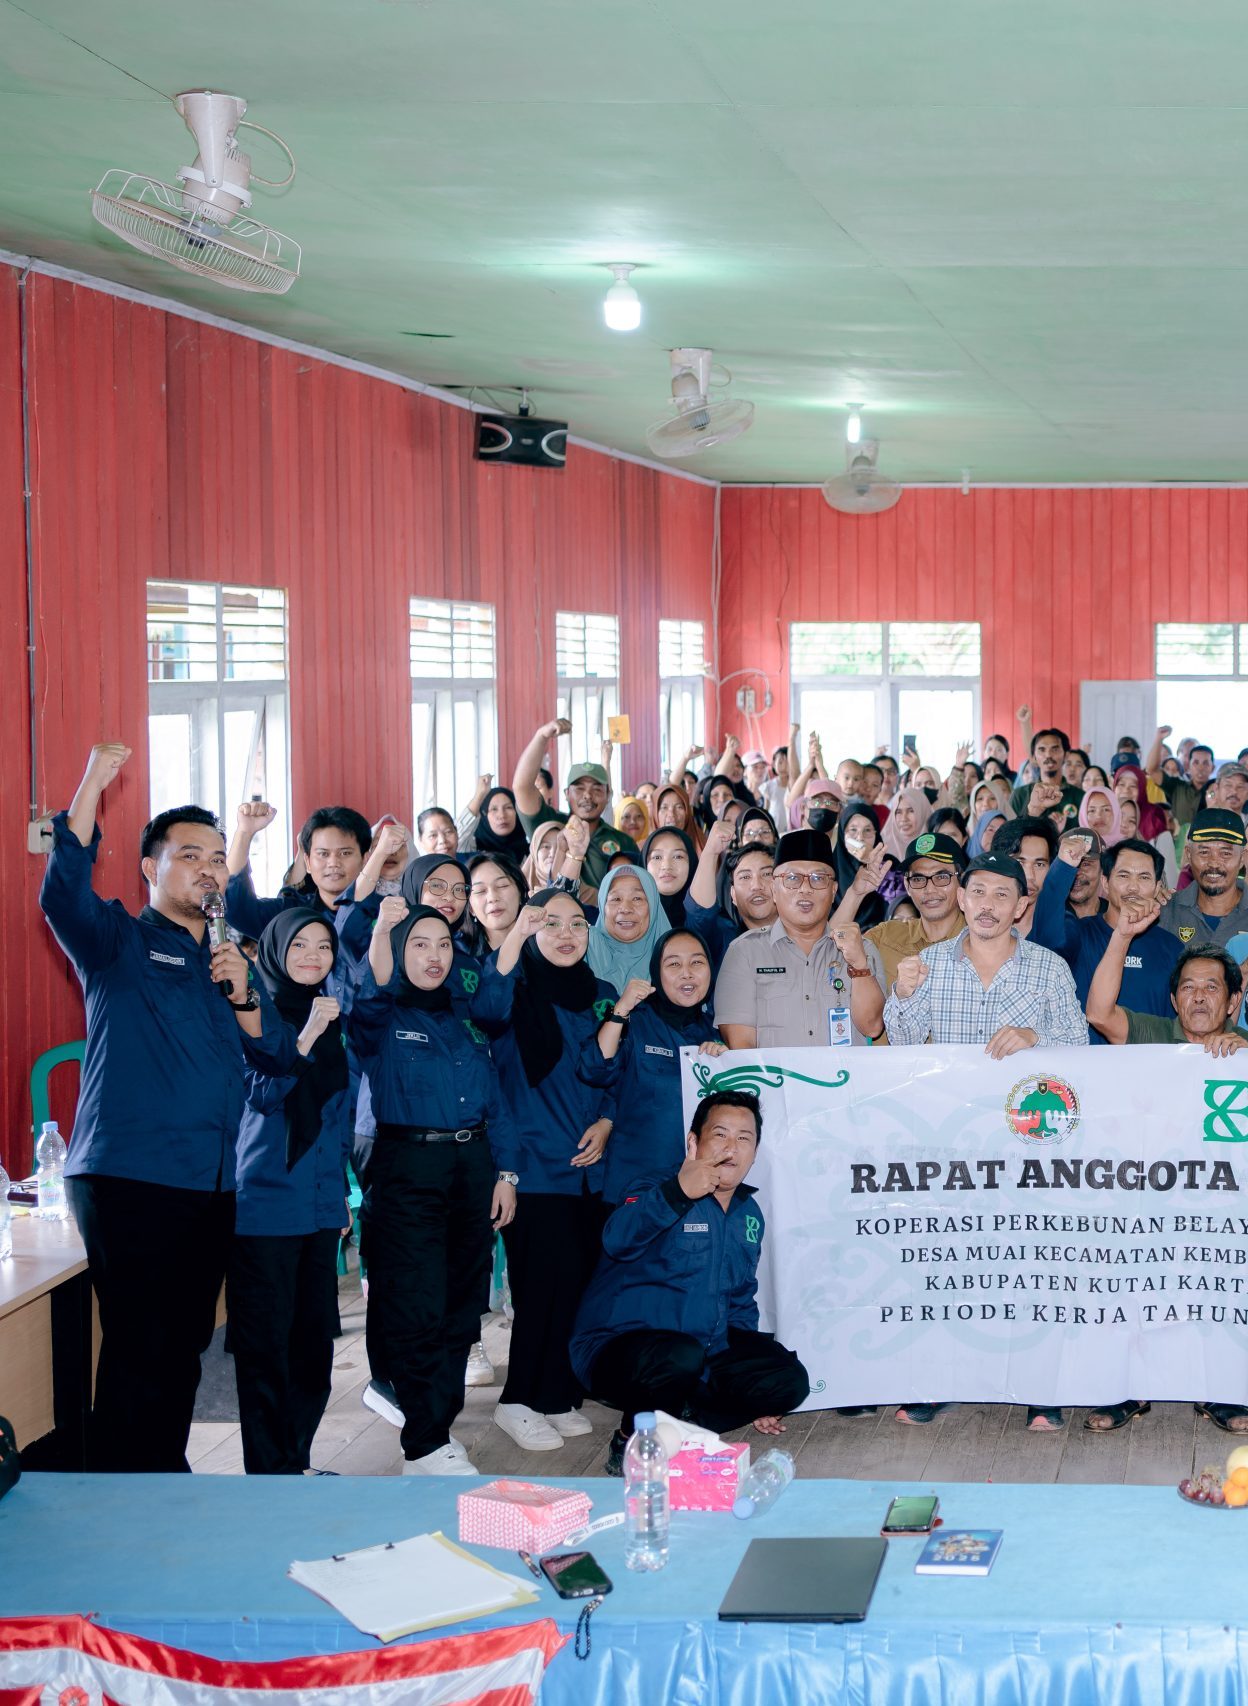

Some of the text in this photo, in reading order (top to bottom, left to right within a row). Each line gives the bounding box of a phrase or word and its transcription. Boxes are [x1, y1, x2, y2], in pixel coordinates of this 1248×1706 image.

[1124, 955, 1142, 965] ORK
[850, 1160, 1005, 1193] RAPAT
[1016, 1159, 1240, 1192] ANGGOTA
[855, 1215, 984, 1236] KOPERASI
[992, 1214, 1165, 1235] PERKEBUNAN
[900, 1246, 958, 1263] DESA
[965, 1245, 1026, 1262] MUAI
[1033, 1245, 1176, 1264] KECAMATAN
[925, 1274, 1077, 1292] KABUPATEN
[1087, 1275, 1167, 1293] KUTAI
[880, 1304, 1017, 1323] PERIODE
[1032, 1304, 1127, 1325] KERJA
[1143, 1304, 1248, 1326] TAHUN
